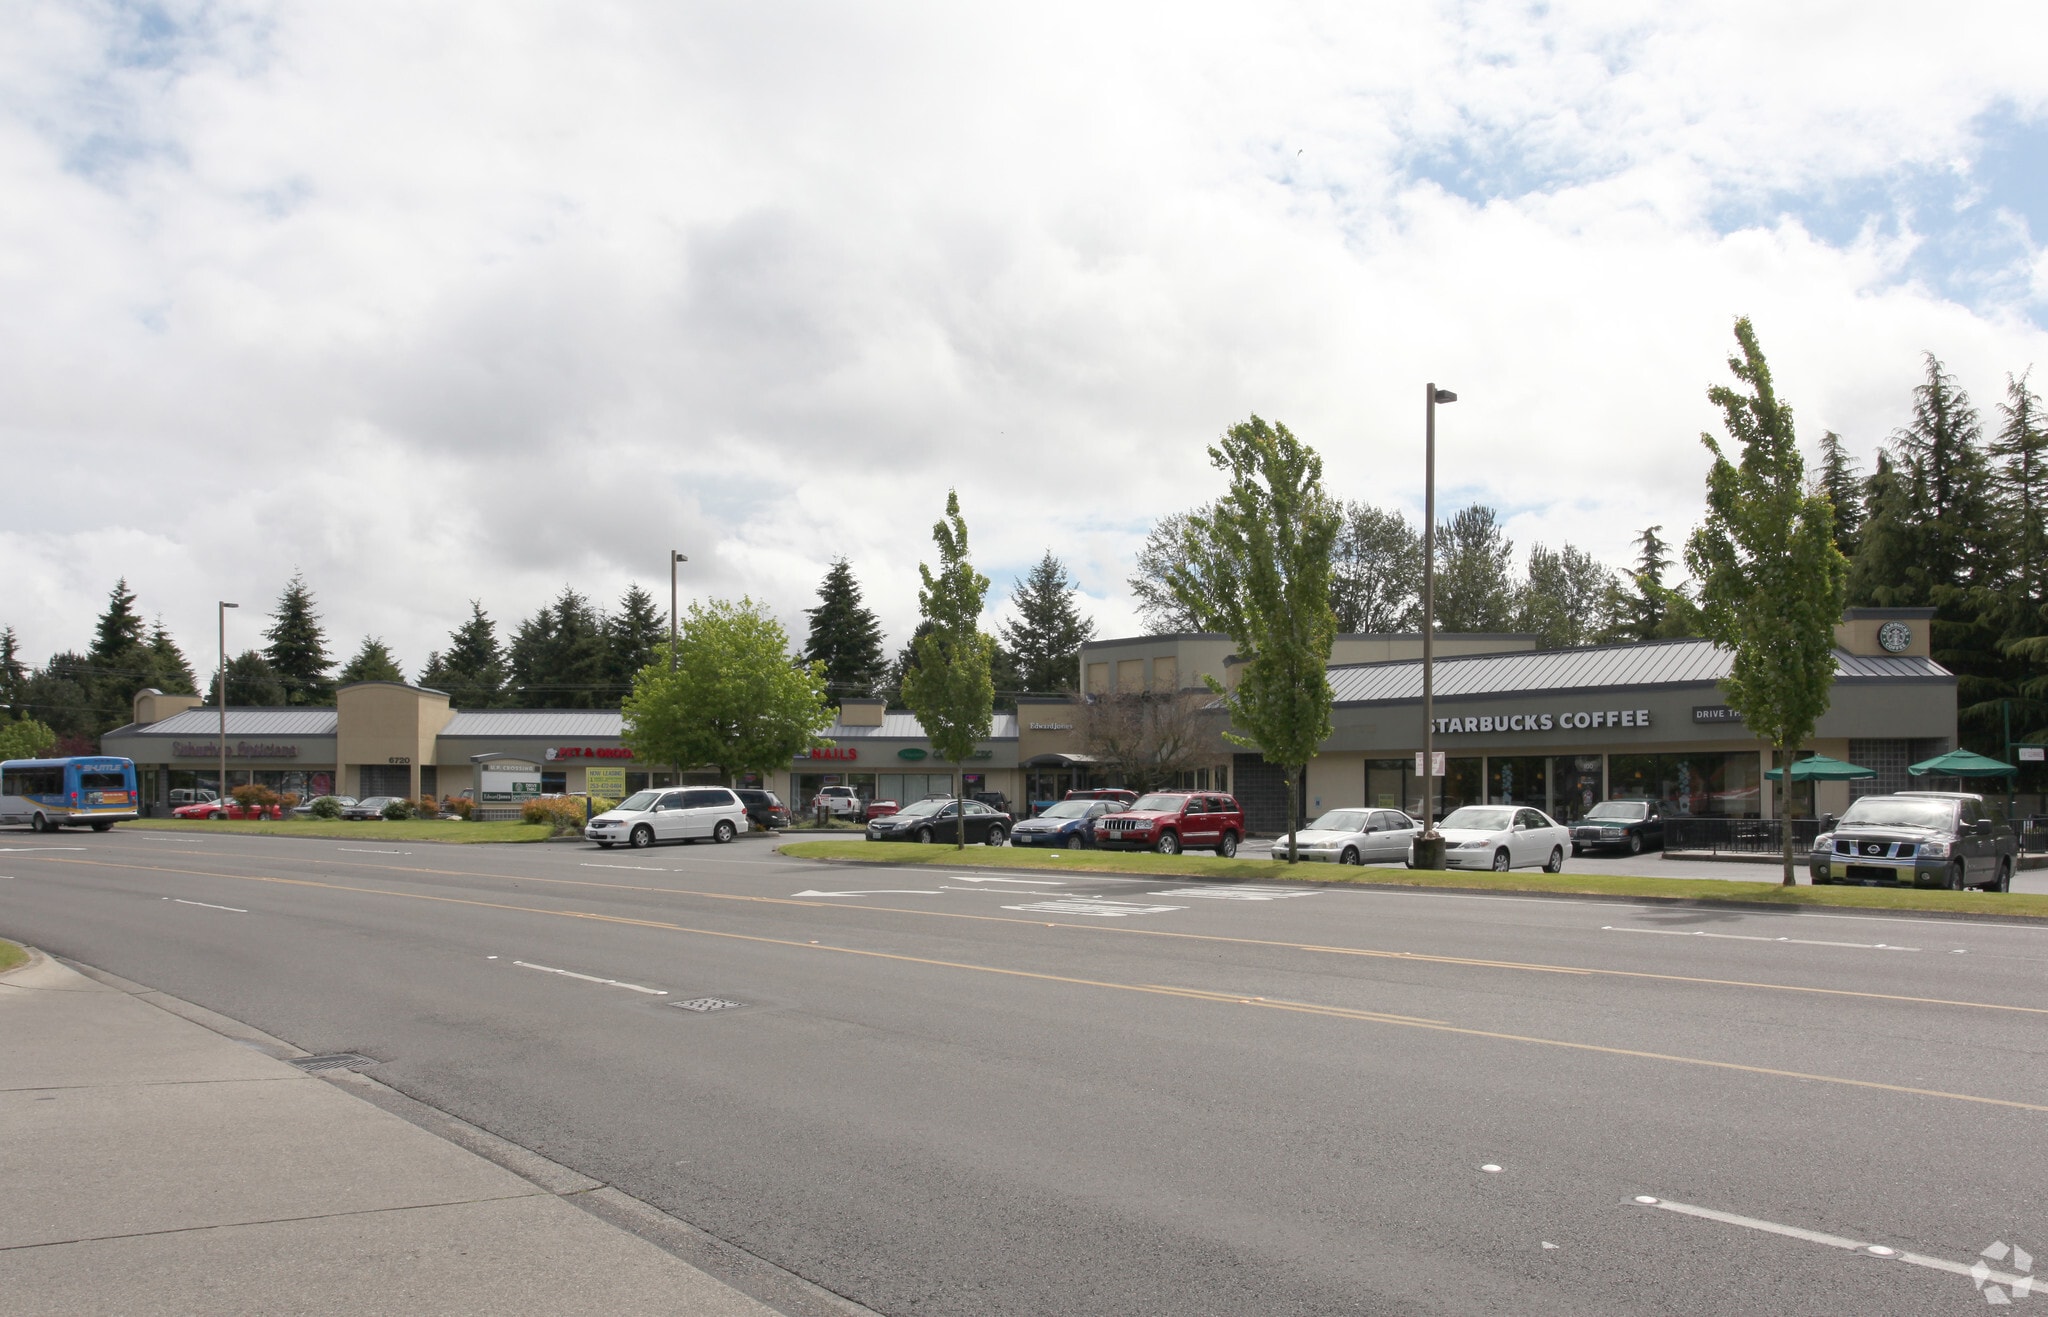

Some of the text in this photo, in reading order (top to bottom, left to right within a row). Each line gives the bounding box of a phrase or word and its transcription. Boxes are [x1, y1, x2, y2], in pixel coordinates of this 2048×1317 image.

[1882, 622, 1910, 635] STARBUCKS
[1559, 709, 1650, 729] COFFEE
[1696, 710, 1725, 718] DRIVE
[584, 747, 593, 757] &
[812, 748, 858, 760] NAILS
[83, 764, 121, 772] SHUTTLE
